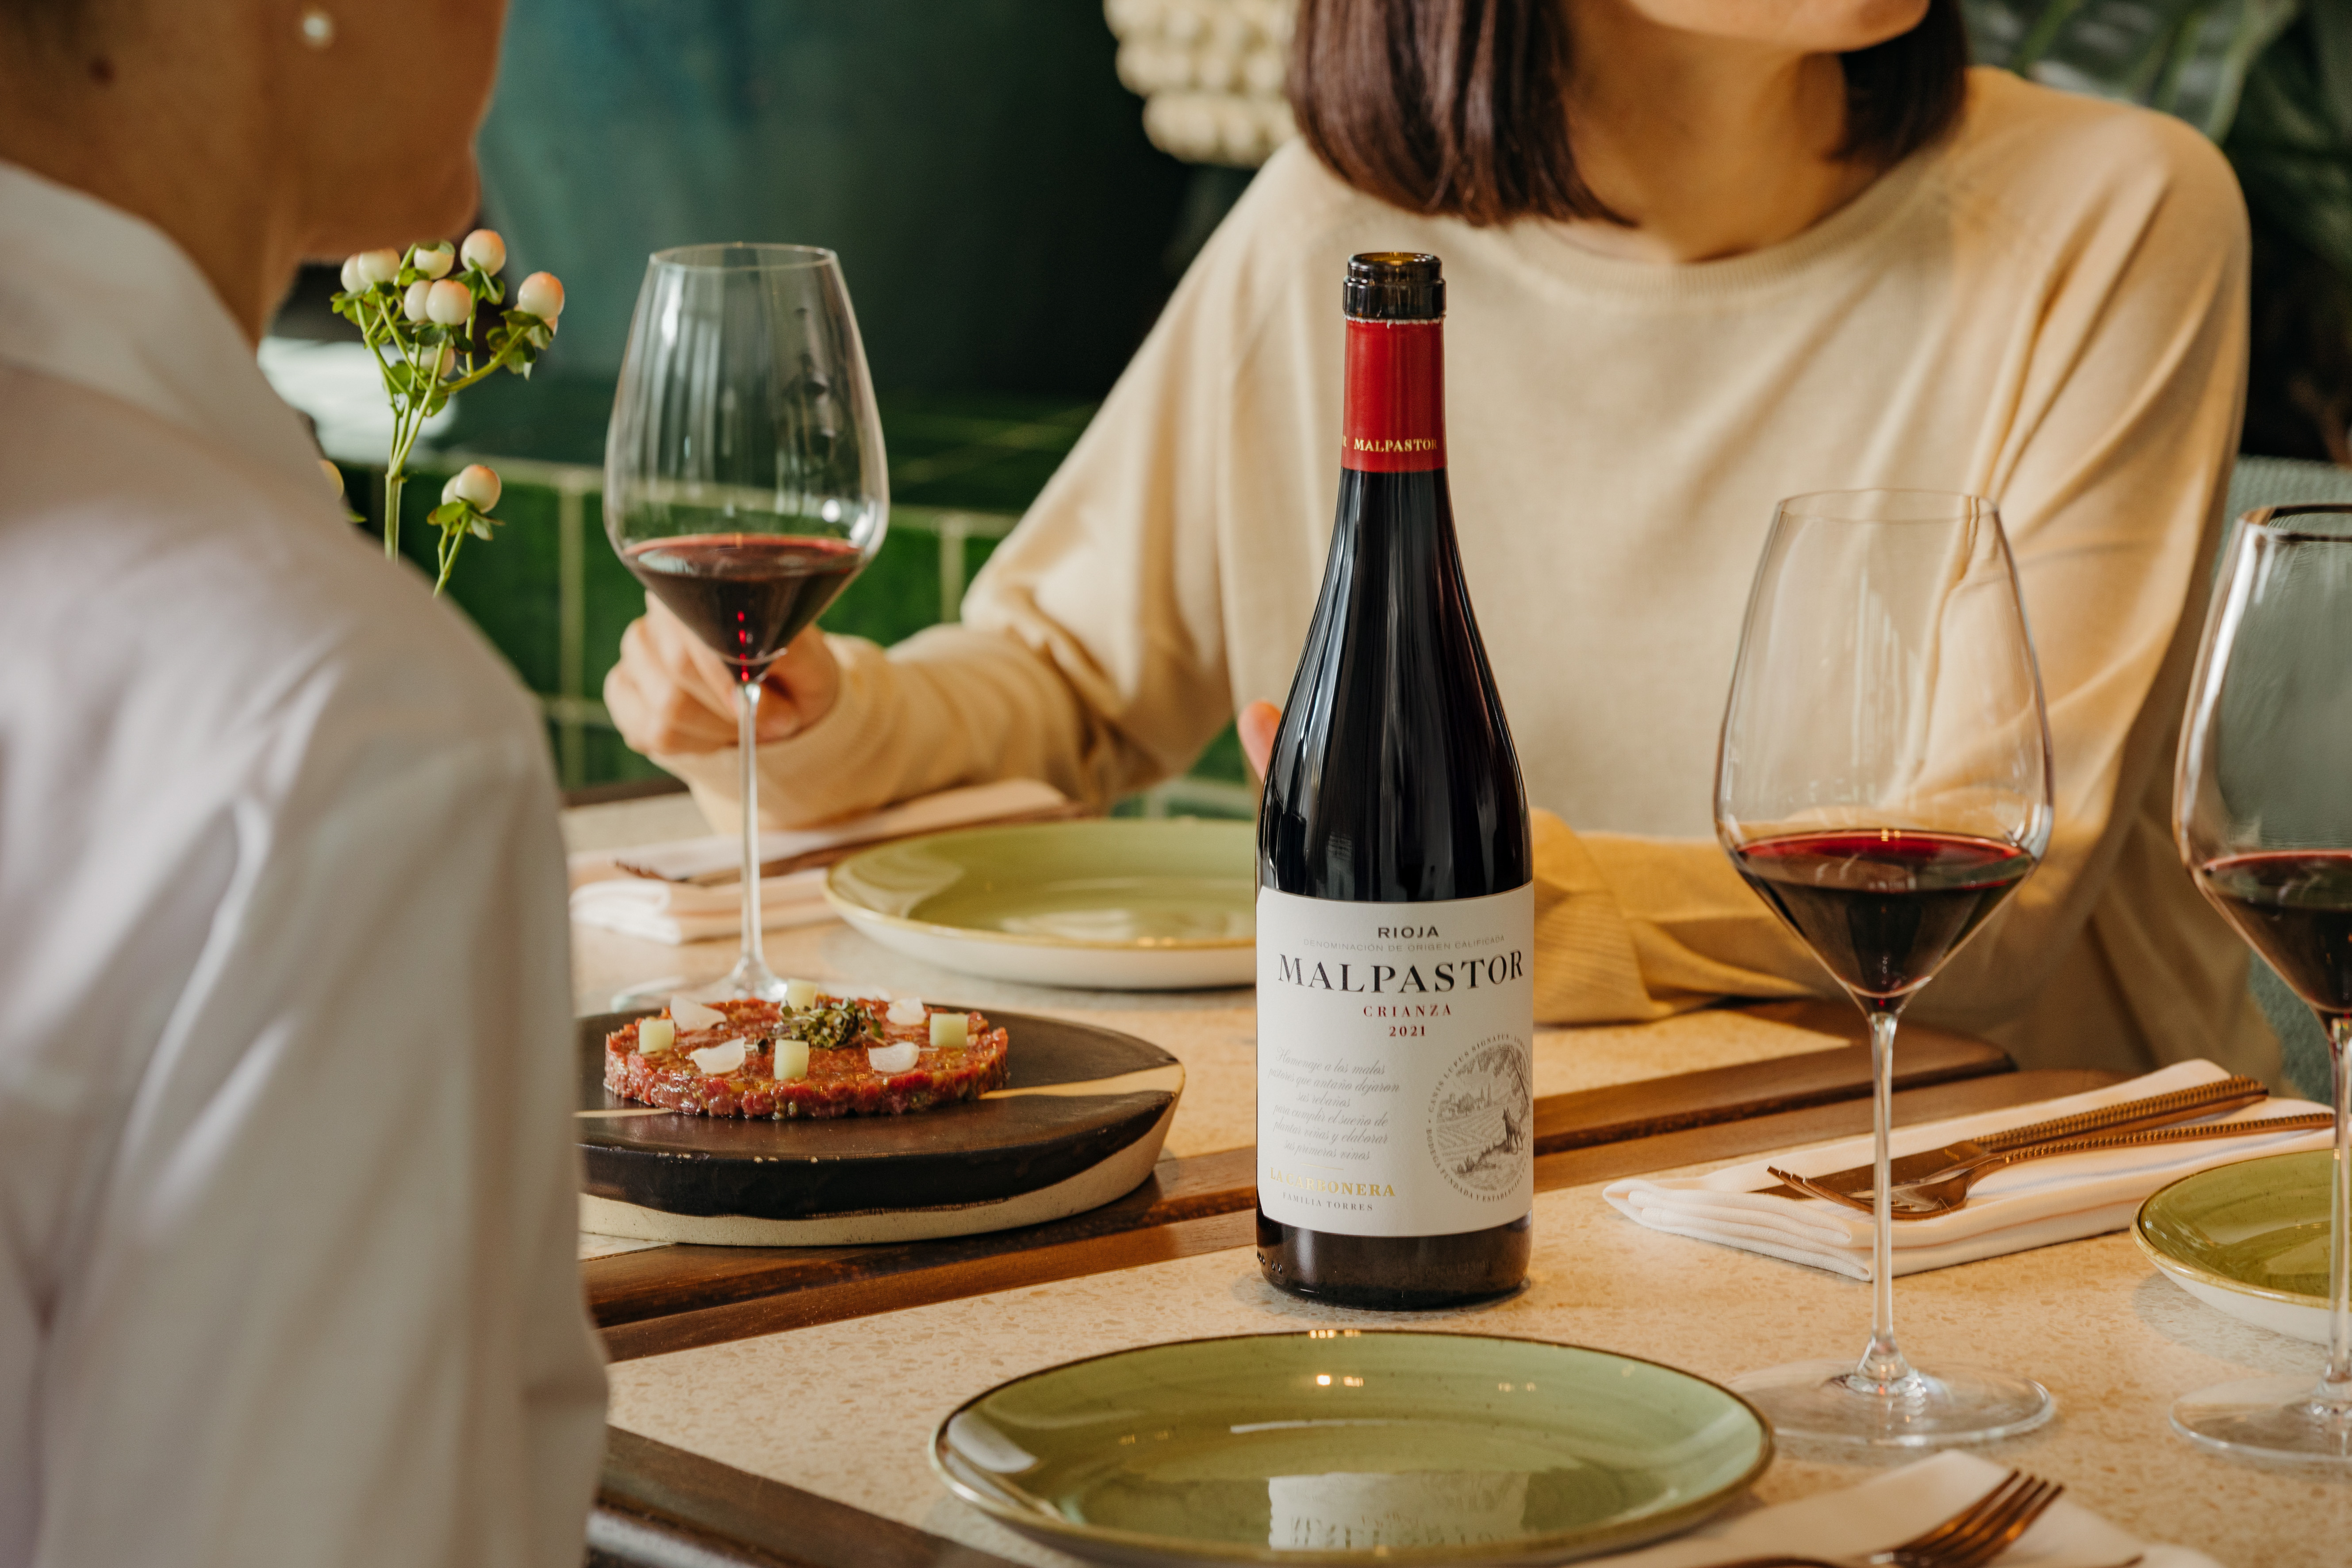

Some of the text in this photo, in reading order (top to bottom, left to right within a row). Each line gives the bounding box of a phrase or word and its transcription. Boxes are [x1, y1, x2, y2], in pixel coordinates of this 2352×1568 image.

[1354, 437, 1437, 452] MALPASTOR
[1304, 939, 1383, 951] DENOMINACIÓN
[1408, 943, 1451, 952] ORIGEN
[1455, 934, 1504, 949] CALIFICADA
[1378, 925, 1439, 939] RIOJA
[1278, 949, 1523, 993] MALPASTOR
[1363, 1002, 1451, 1017] CRIANZA
[1389, 1024, 1426, 1037] 2021
[1276, 1047, 1322, 1073] Homenaje
[1334, 1058, 1349, 1073] los
[1352, 1060, 1385, 1075] malos
[1268, 1068, 1400, 1096] pastores que antaño dejaron
[1428, 1081, 1444, 1112] CANIS
[1444, 1050, 1469, 1079] LUPUS
[1472, 1034, 1509, 1052] SIGNATUS
[1296, 1091, 1351, 1108] sus rebaños
[1273, 1104, 1388, 1127] para cumplir el sueño de
[1273, 1116, 1388, 1145] plantar viñas y elaborar
[1284, 1140, 1370, 1161] sus primeros vinos
[1426, 1129, 1441, 1169] BODEGA
[1440, 1168, 1473, 1199] FUNDADA
[1270, 1167, 1396, 1197] LA CARBONERA
[1283, 1192, 1373, 1211] FAMILIA TORRES
